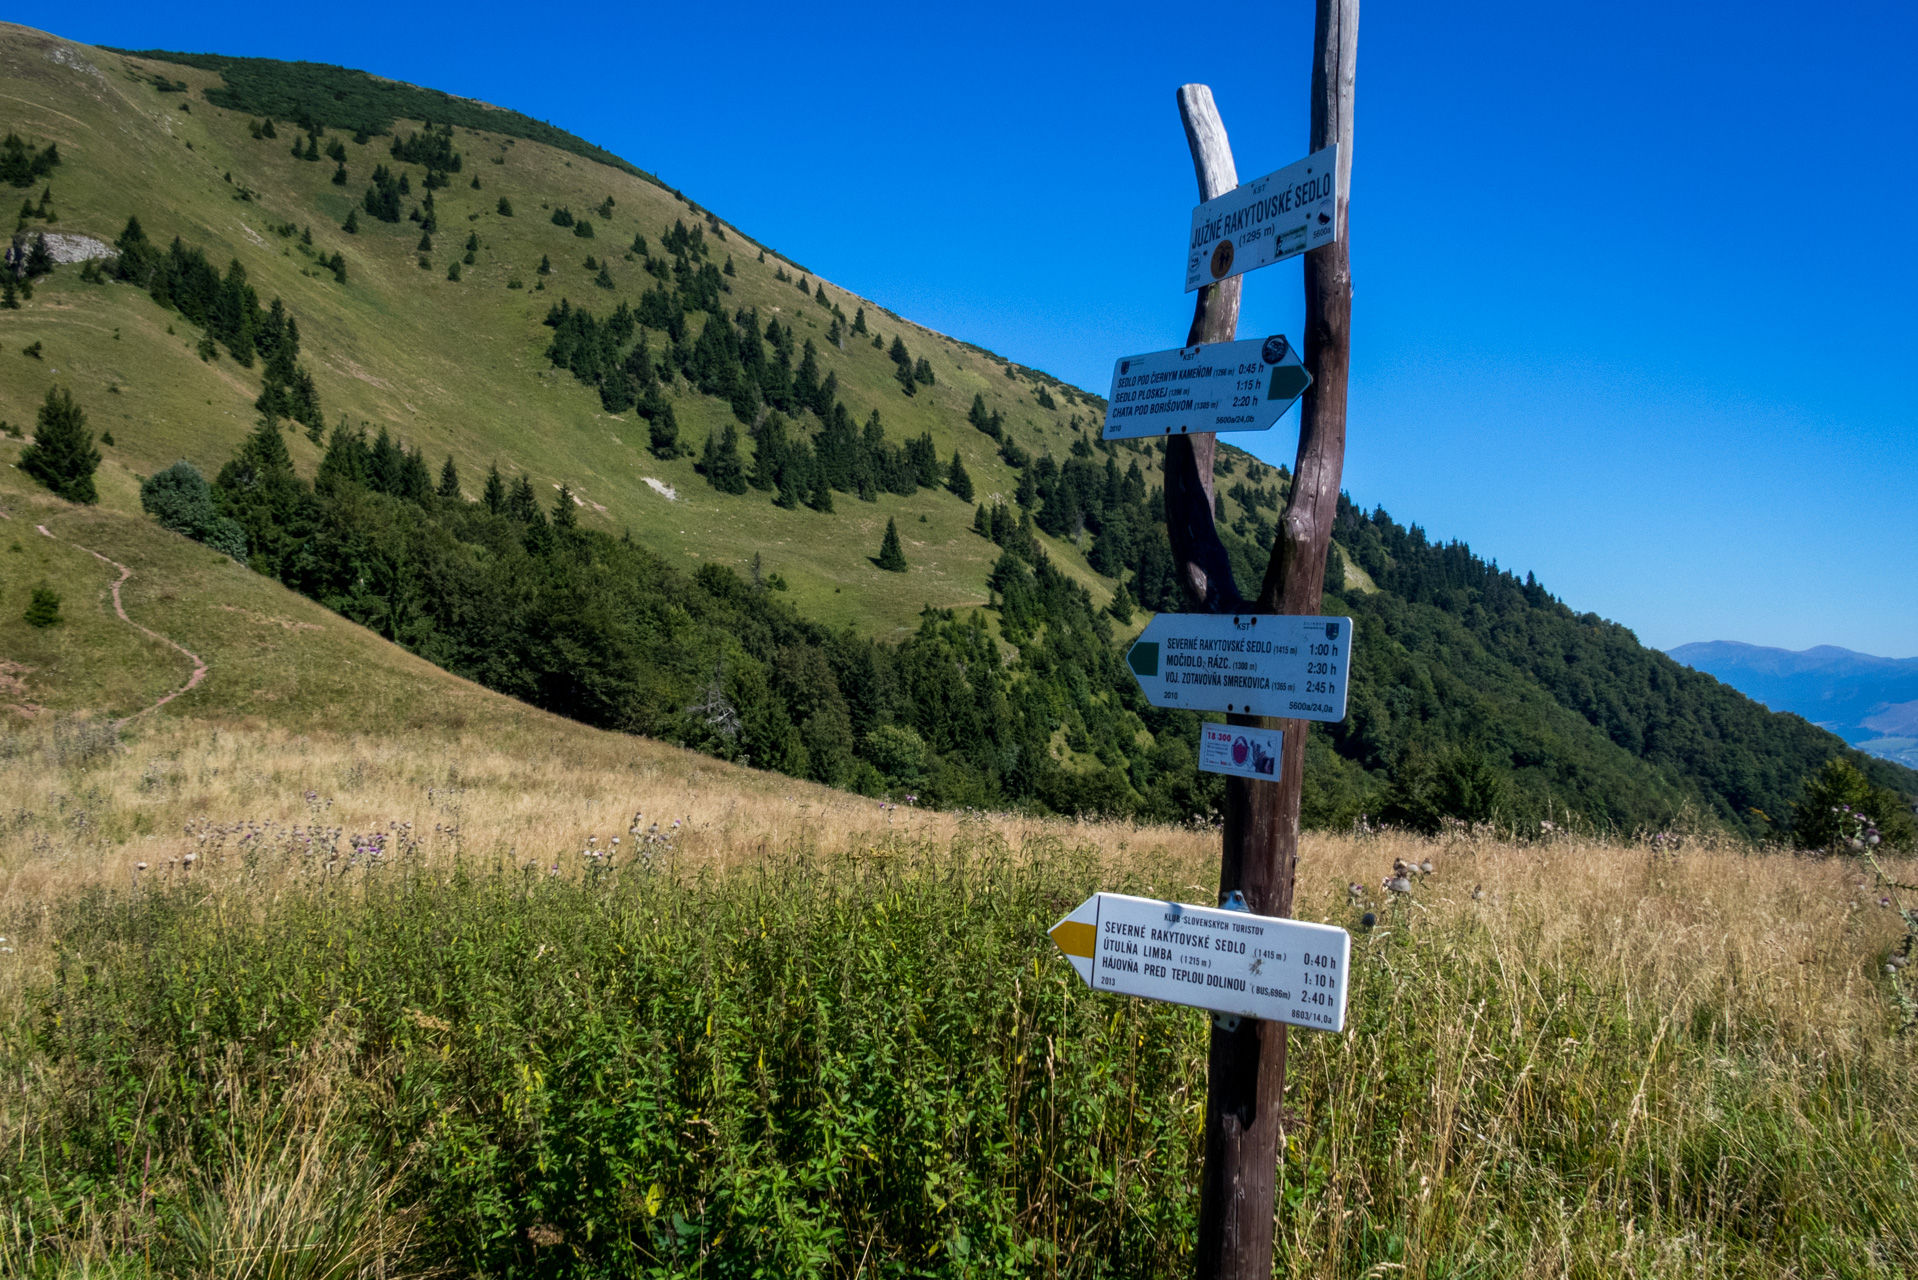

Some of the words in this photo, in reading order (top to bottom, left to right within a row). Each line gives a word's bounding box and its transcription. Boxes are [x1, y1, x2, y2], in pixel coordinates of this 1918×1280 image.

[1192, 213, 1223, 249] JUŽNÉ
[1224, 183, 1293, 236] RAKYTOVSKÉ
[1295, 173, 1330, 208] SEDLO
[1239, 228, 1261, 247] (1295
[1263, 223, 1276, 238] m)
[1183, 353, 1195, 361] KST
[1118, 376, 1136, 388] SEDLO
[1137, 375, 1149, 385] POD
[1151, 371, 1178, 384] ČIERNYM
[1178, 365, 1212, 380] KAMEŇOM
[1238, 364, 1256, 374] 0:45
[1258, 363, 1264, 373] h
[1115, 391, 1136, 403] SEDLO
[1138, 387, 1168, 399] PLOSKEJ
[1236, 380, 1253, 390] 1:15
[1255, 379, 1261, 389] h
[1113, 406, 1133, 418] CHATA
[1134, 404, 1149, 416] POD
[1150, 400, 1193, 414] BORIŠOVOM
[1232, 396, 1250, 407] 2:20
[1252, 396, 1258, 407] h
[1109, 425, 1121, 433] 2010
[1236, 623, 1250, 631] KST
[1167, 636, 1198, 650] SEVERNÉ
[1199, 638, 1245, 652] RAKYTOVSKÉ
[1246, 640, 1272, 654] SEDLO
[1273, 646, 1289, 655] (1415
[1310, 644, 1329, 656] 1:00
[1332, 644, 1338, 656] h
[1207, 654, 1231, 669] RÁZC.
[1307, 662, 1327, 675] 2:30
[1330, 663, 1336, 675] h
[1166, 672, 1180, 684] VOJ.
[1182, 672, 1221, 686] ZOTAVOVŇA
[1223, 675, 1270, 690] SMREKOVICA
[1306, 681, 1326, 694] 2:45
[1329, 682, 1335, 694] h
[1289, 702, 1333, 713] 5600a/24,0a
[1208, 732, 1216, 740] 18
[1218, 733, 1231, 742] 300
[1164, 913, 1180, 923] KLUB
[1183, 916, 1229, 930] SLOVENSKÝCH
[1232, 923, 1264, 936] TURISTOV
[1105, 921, 1146, 939] SEVERNÉ
[1151, 928, 1210, 949] RAKYTOVSKÉ
[1215, 938, 1246, 955] SEDLO
[1303, 953, 1327, 968] 0:40
[1330, 956, 1336, 969] h
[1103, 936, 1138, 956] ÚTULŇA
[1143, 945, 1172, 961] LIMBA
[1304, 972, 1326, 987] 1:10
[1329, 976, 1335, 989] h
[1101, 976, 1116, 986] 2013
[1102, 955, 1139, 974] HÁJOVŇA
[1144, 963, 1166, 978] PRED
[1172, 967, 1204, 984] TEPLOU
[1206, 974, 1246, 992] DOLINOU
[1301, 990, 1325, 1005] 2:40
[1328, 994, 1334, 1007] h
